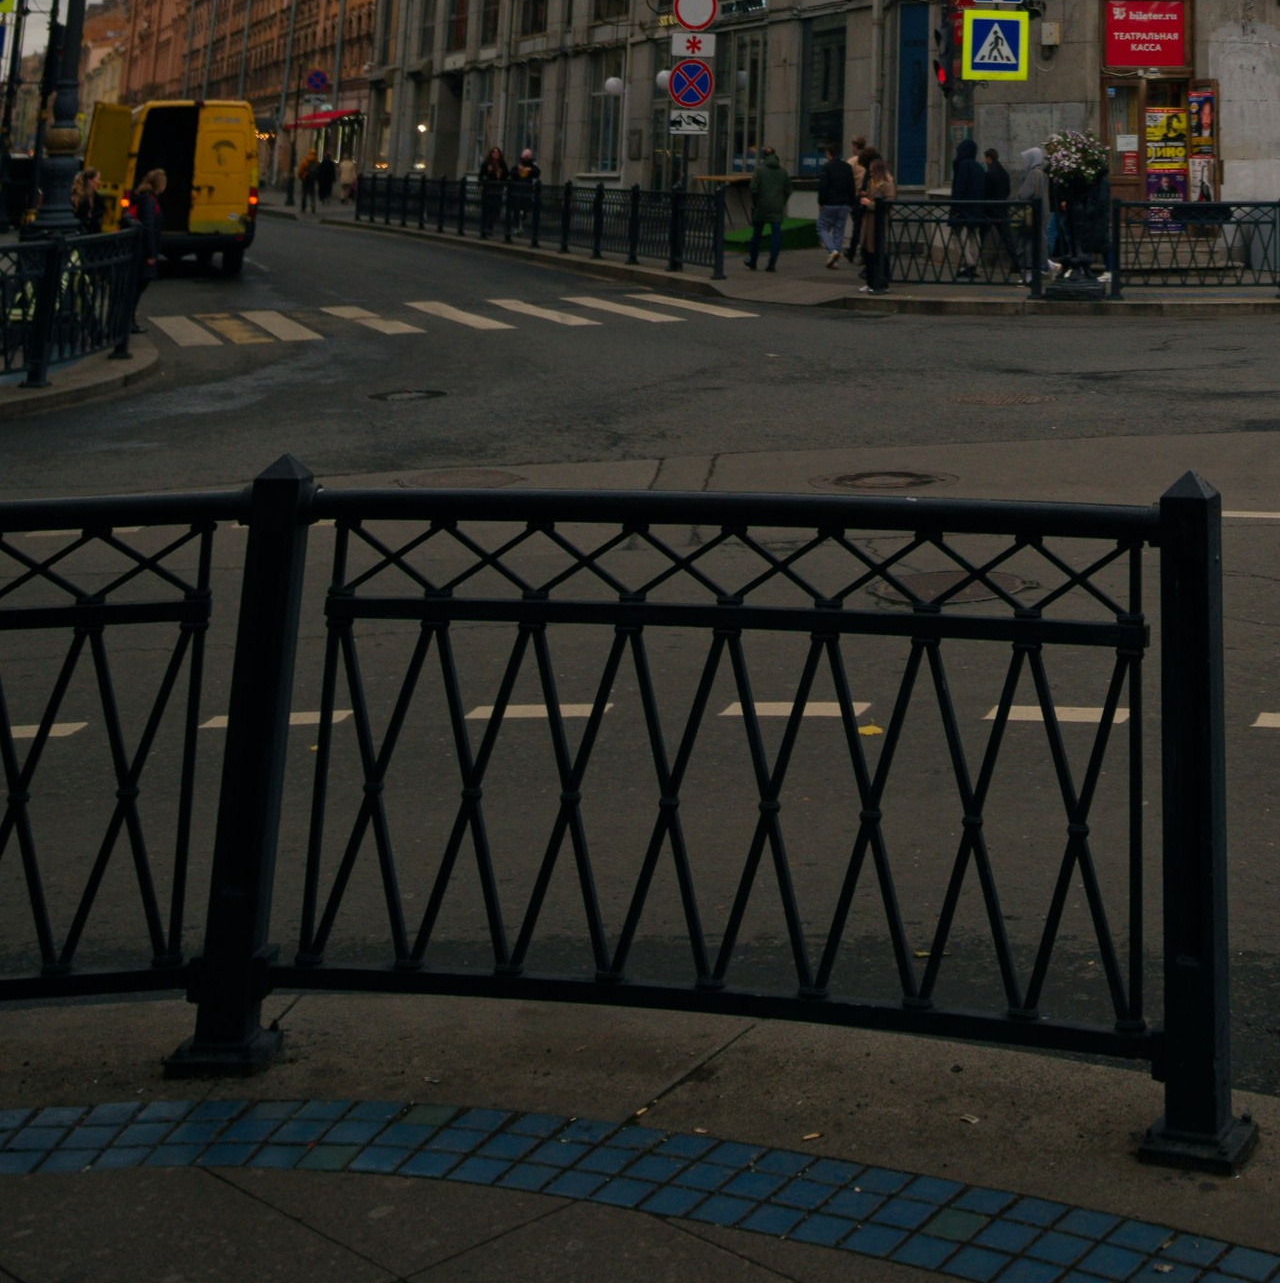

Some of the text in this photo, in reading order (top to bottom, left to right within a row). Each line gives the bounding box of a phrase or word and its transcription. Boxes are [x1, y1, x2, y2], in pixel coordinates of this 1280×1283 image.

[1129, 10, 1178, 21] bileter.ru
[1113, 32, 1179, 41] ТЕАТРАЛЬНАЯ
[1130, 43, 1162, 52] КАССА
